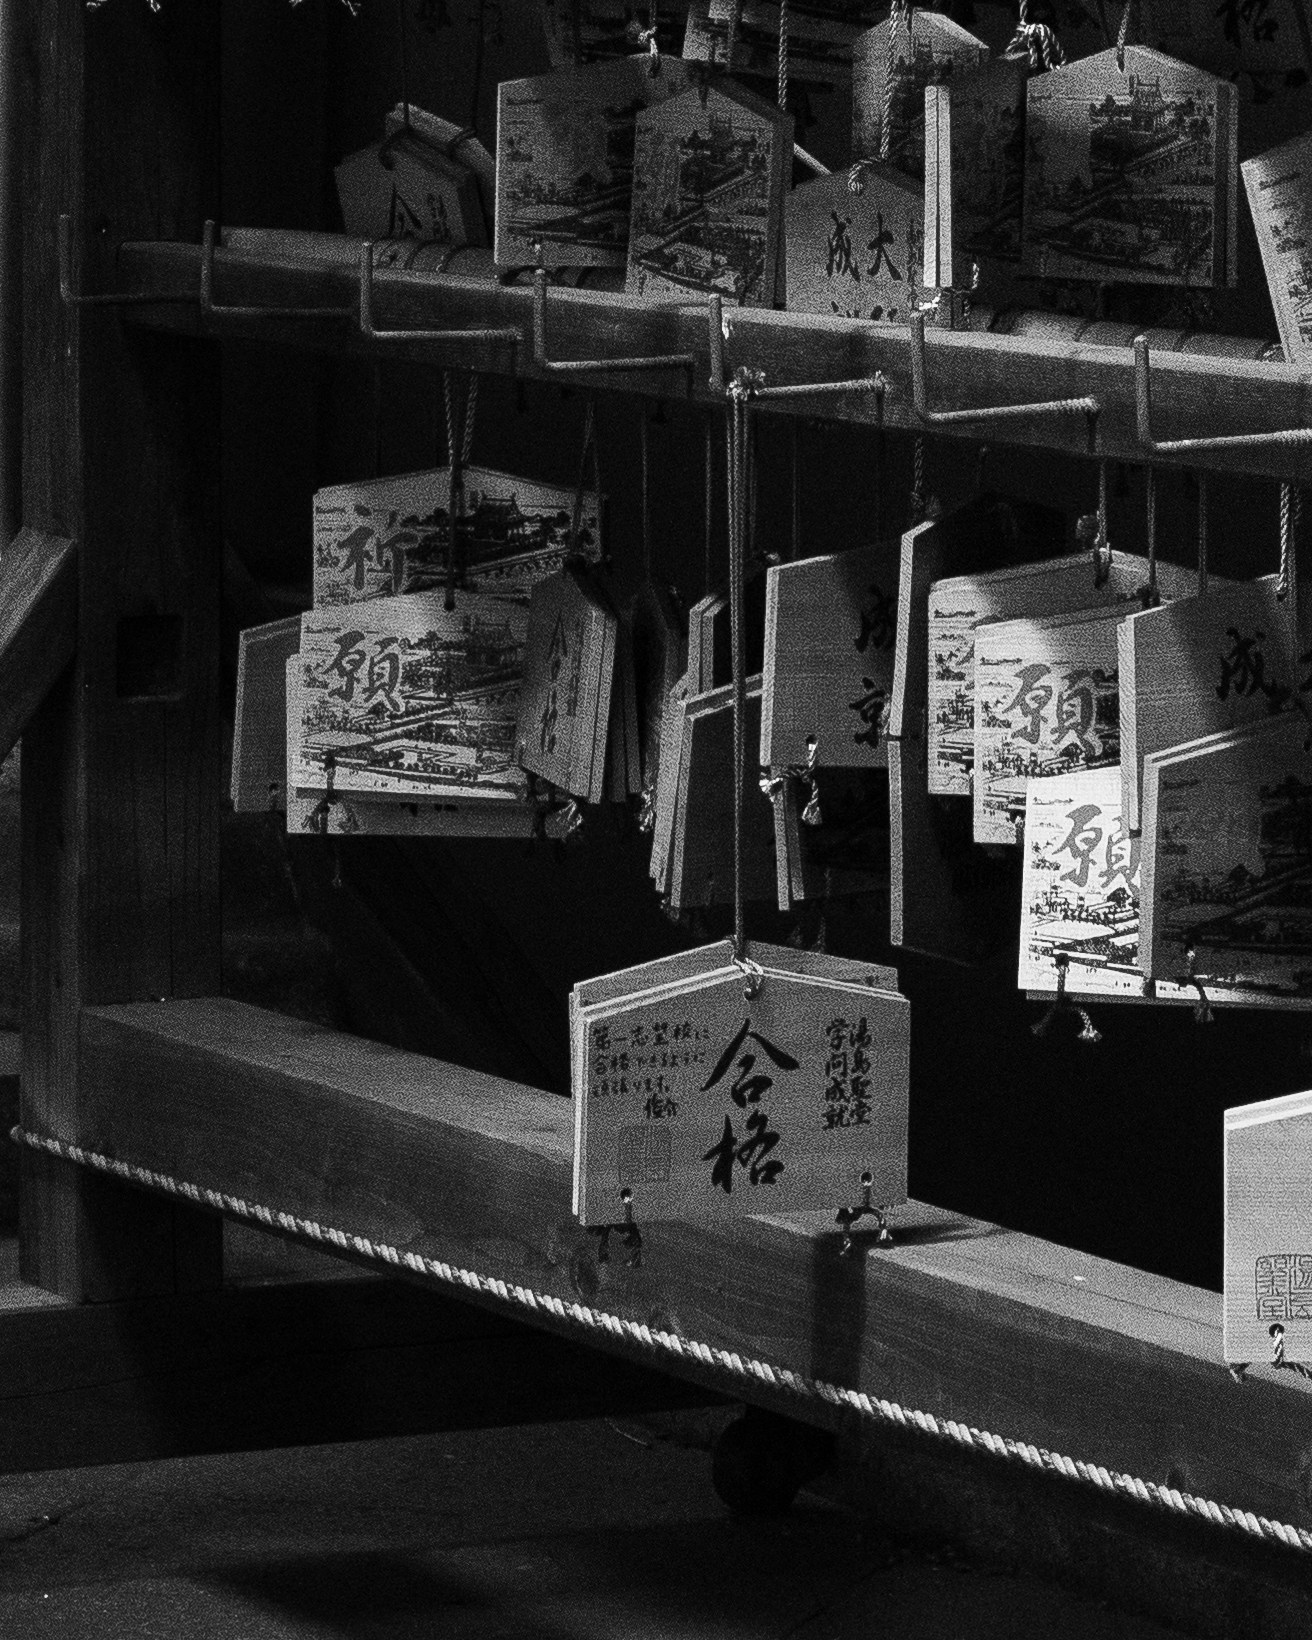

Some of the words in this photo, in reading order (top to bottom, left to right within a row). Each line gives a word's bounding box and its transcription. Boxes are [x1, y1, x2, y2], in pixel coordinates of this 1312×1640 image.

[699, 1018, 801, 1195] 合格
[846, 1017, 873, 1127] 湯島聖堂
